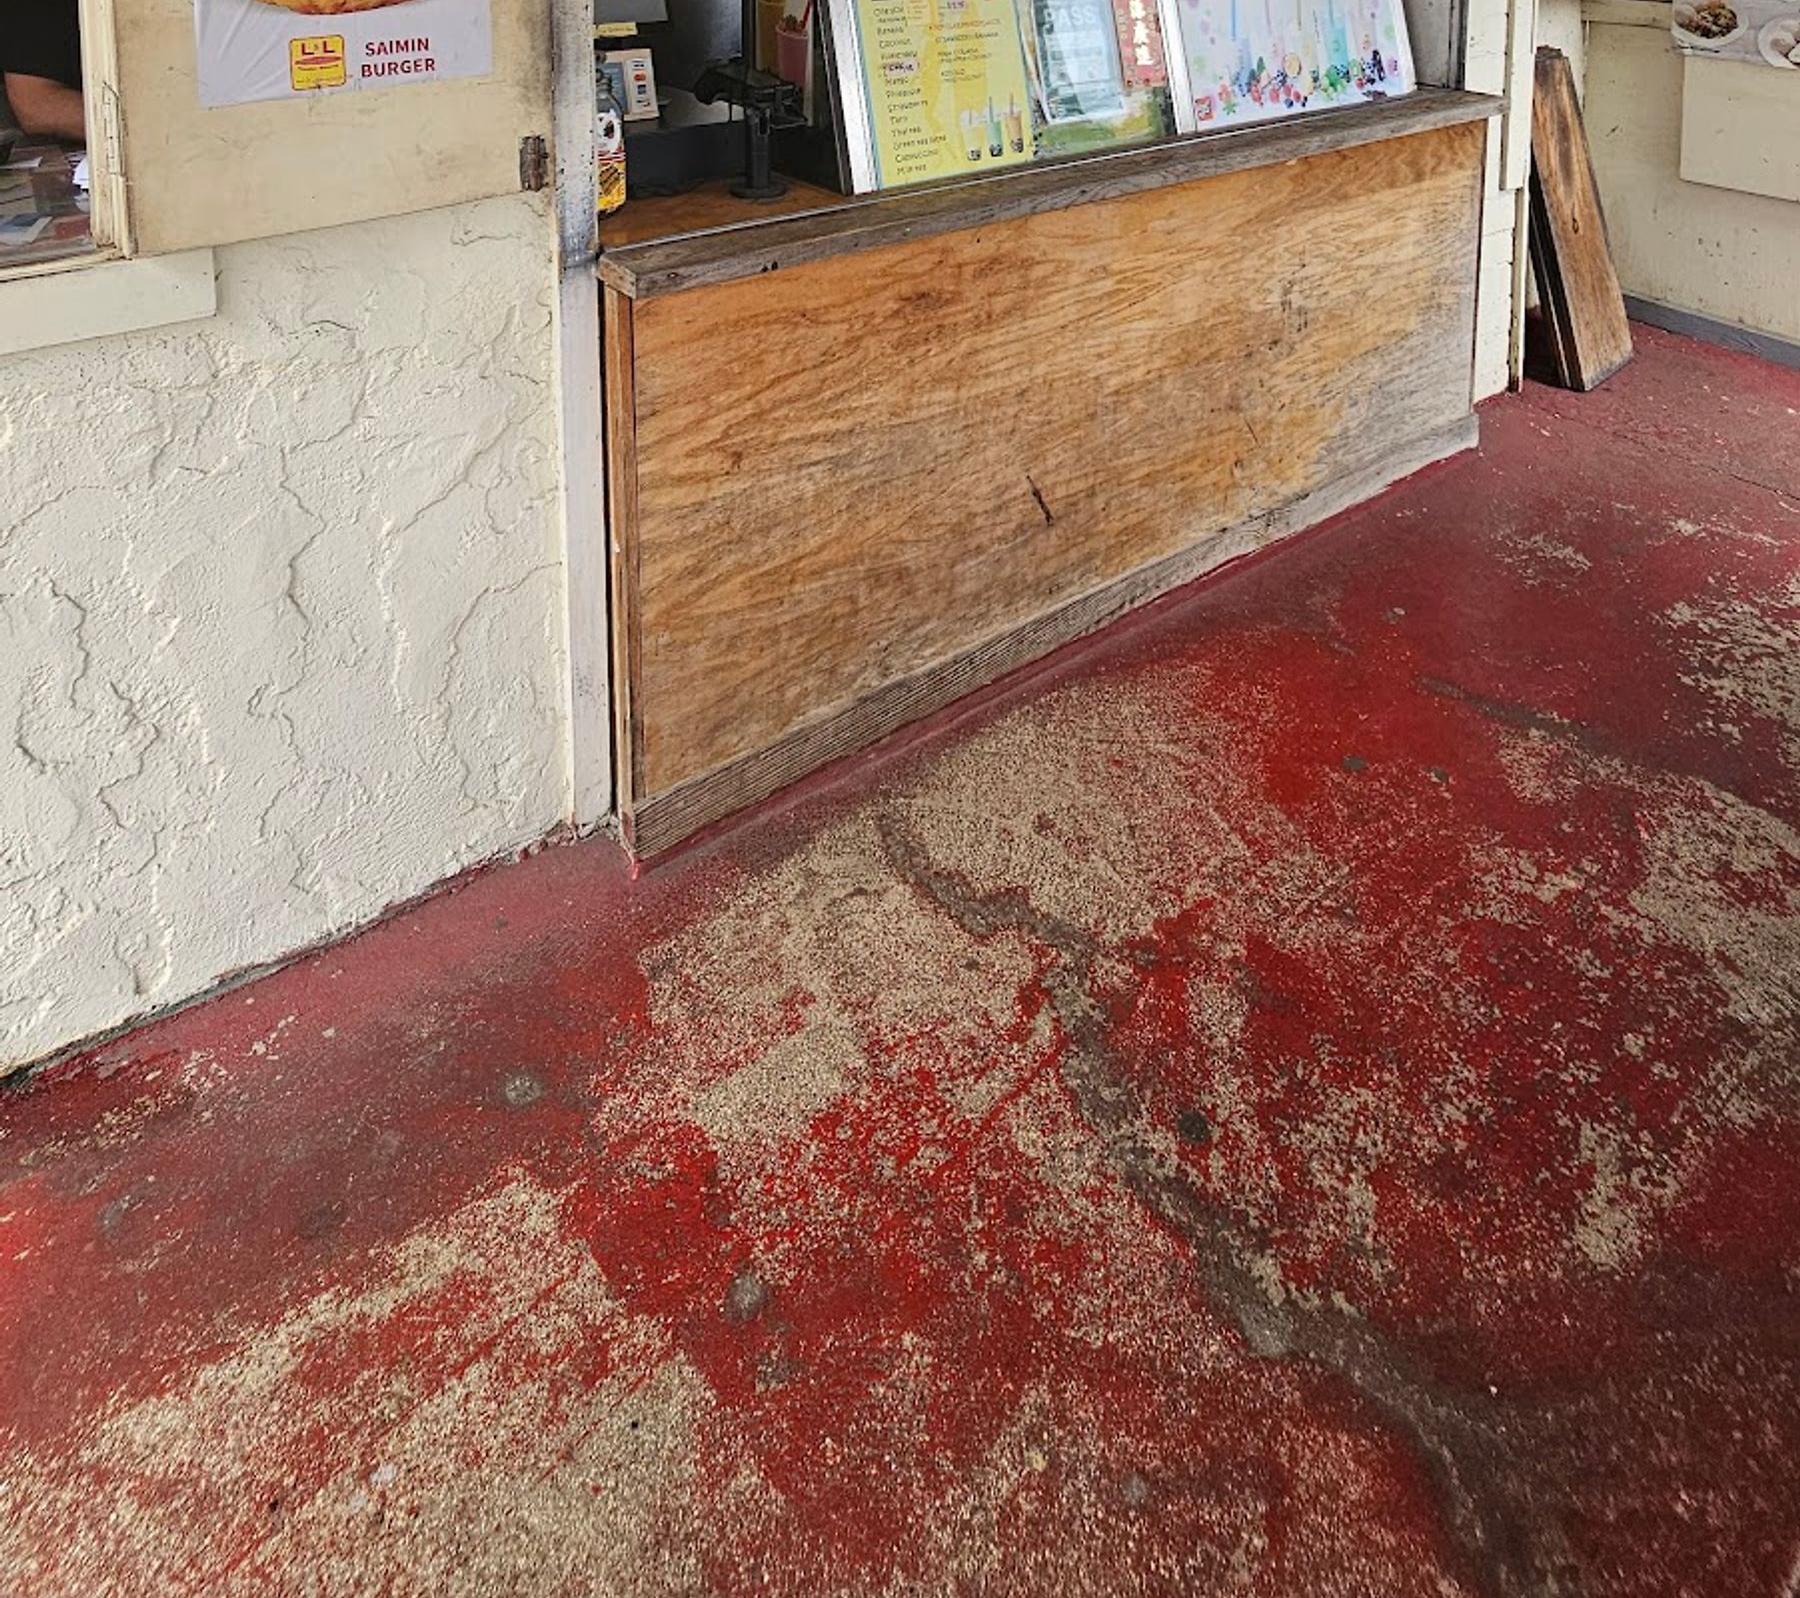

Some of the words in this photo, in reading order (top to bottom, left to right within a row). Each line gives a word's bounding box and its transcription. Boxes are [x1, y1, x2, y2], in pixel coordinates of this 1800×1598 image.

[1044, 5, 1098, 27] PASS
[365, 37, 430, 57] SAIMIN
[361, 57, 436, 78] BURGER
